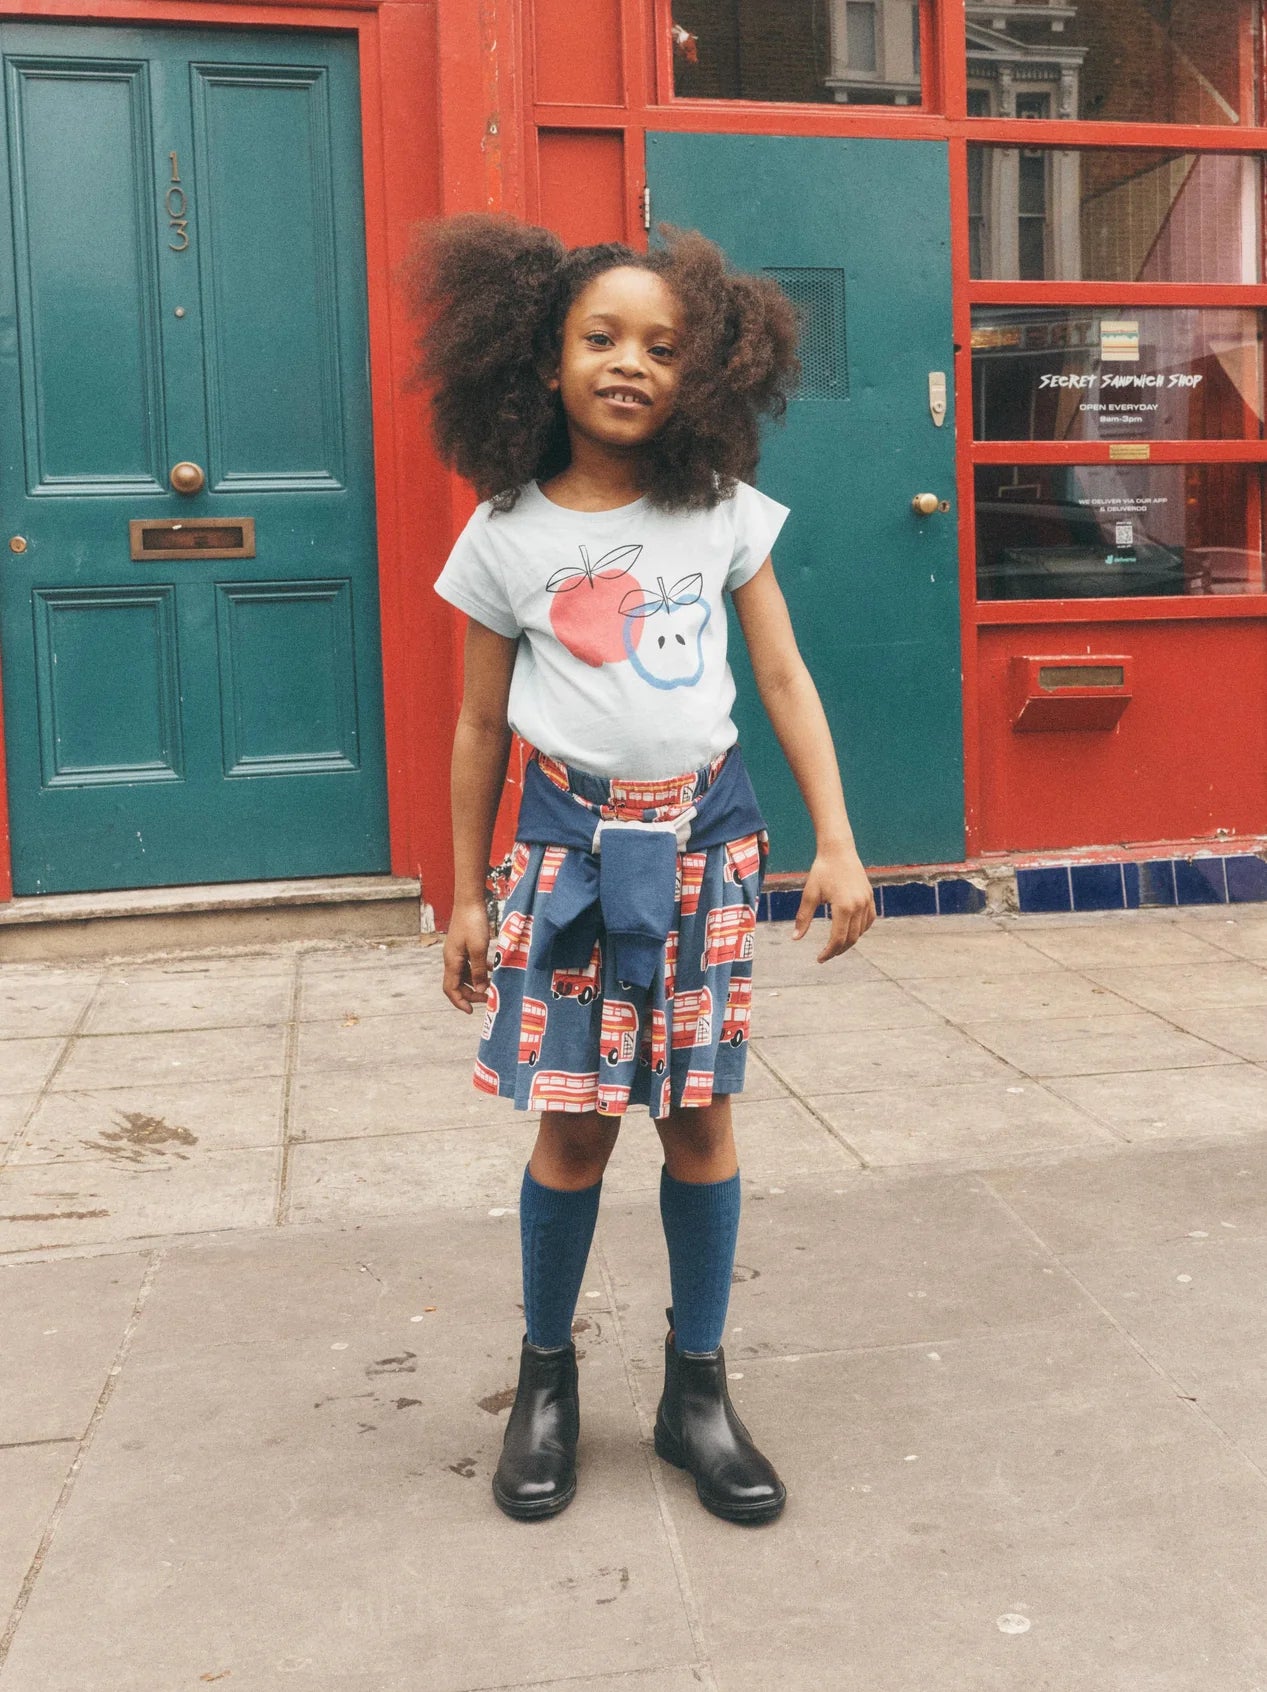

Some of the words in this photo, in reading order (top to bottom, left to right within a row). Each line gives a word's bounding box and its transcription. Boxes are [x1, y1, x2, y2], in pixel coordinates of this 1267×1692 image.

[166, 150, 190, 252] 103
[1038, 374, 1097, 388] SECRET
[1167, 374, 1202, 388] SHOP
